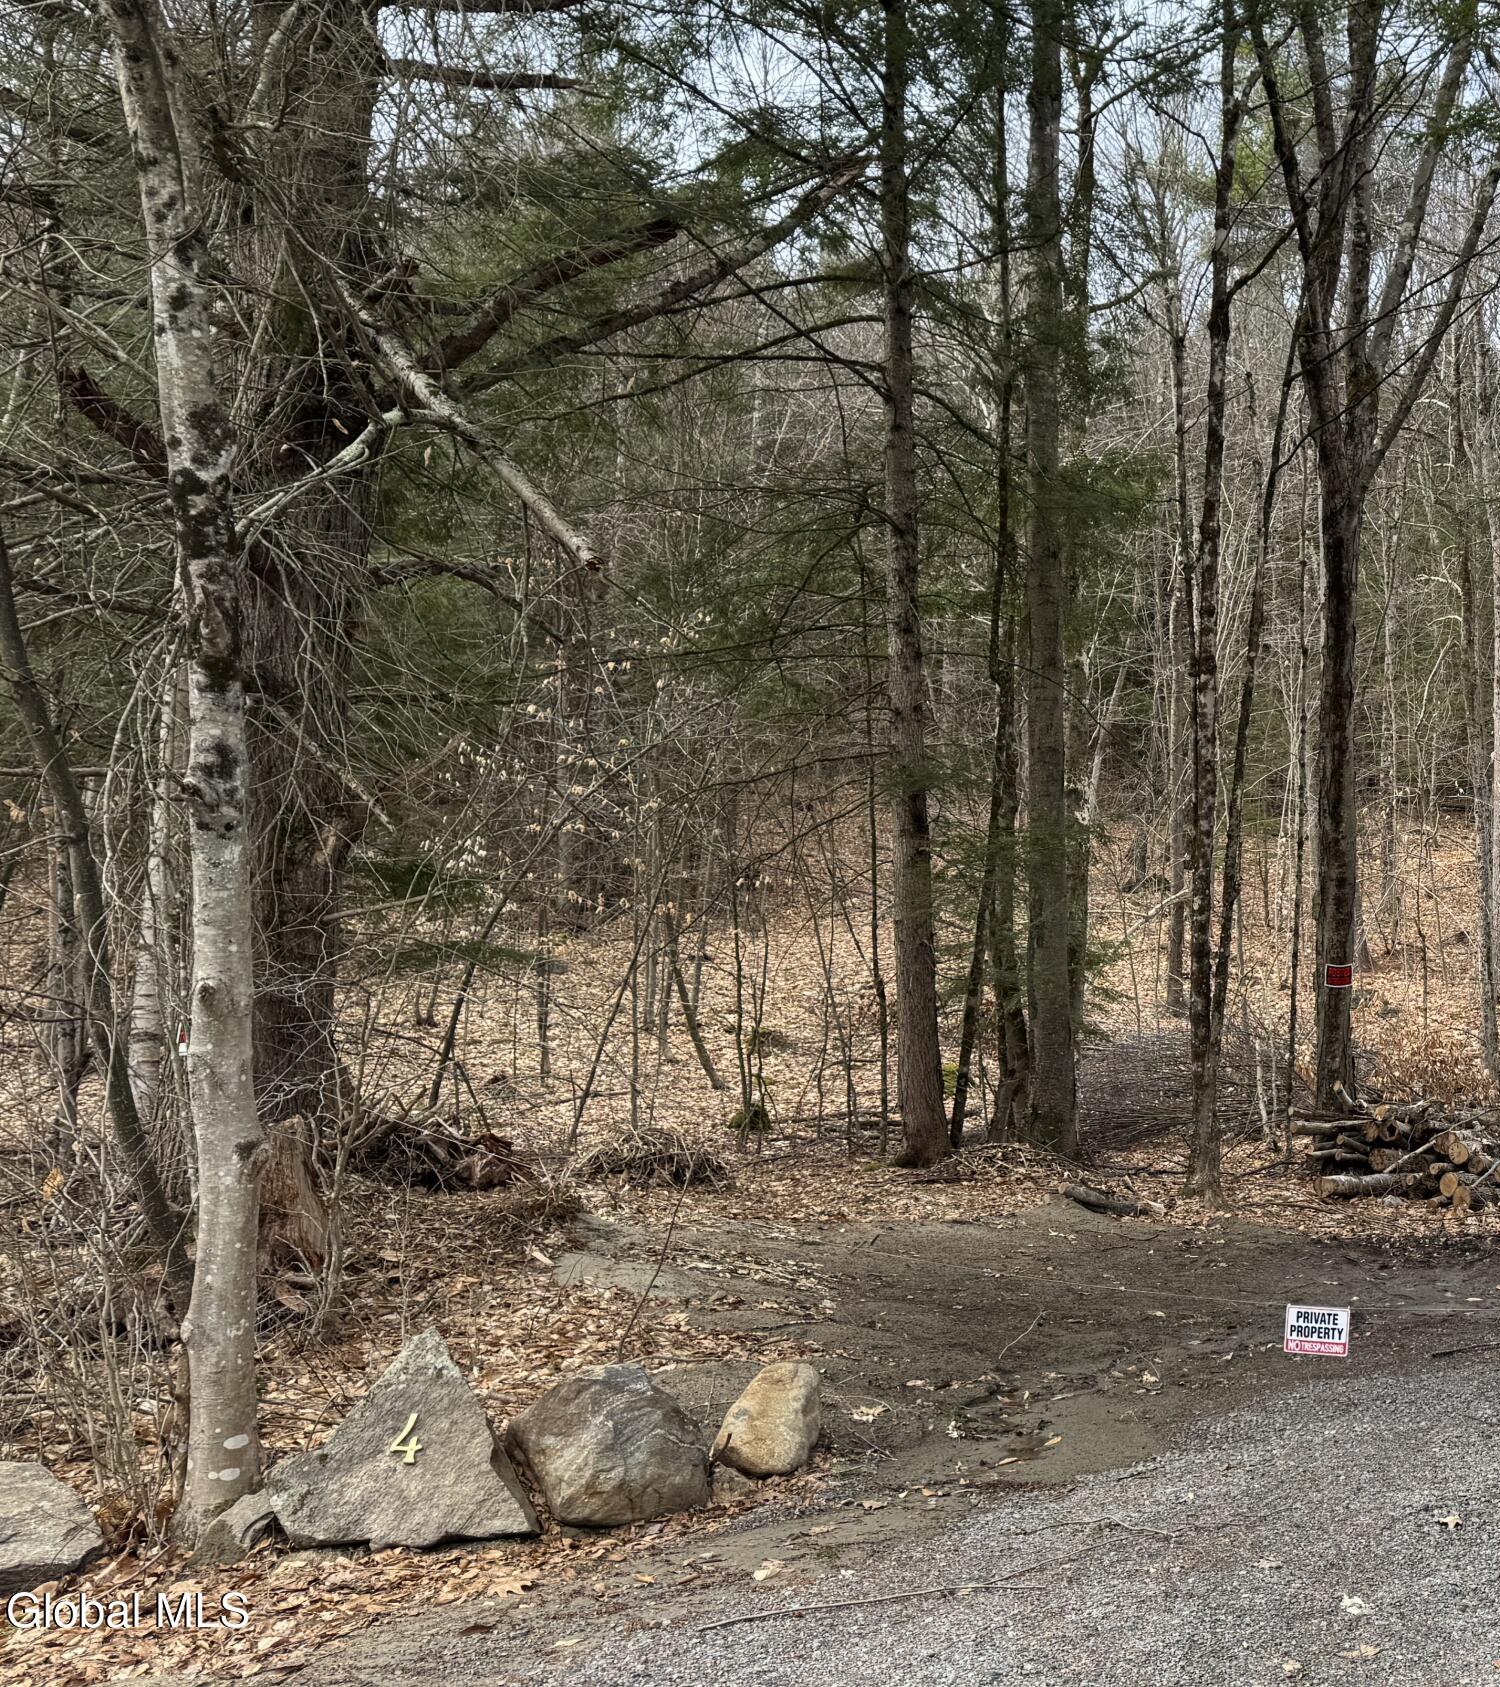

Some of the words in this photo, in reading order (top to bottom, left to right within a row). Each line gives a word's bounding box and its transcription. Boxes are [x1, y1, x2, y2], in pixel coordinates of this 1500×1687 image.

[1296, 1311, 1339, 1326] PRIVATE
[1290, 1324, 1344, 1341] PROPERTY
[1287, 1340, 1301, 1351] NO
[1301, 1341, 1344, 1353] TRESPASSING
[389, 1412, 423, 1463] 4
